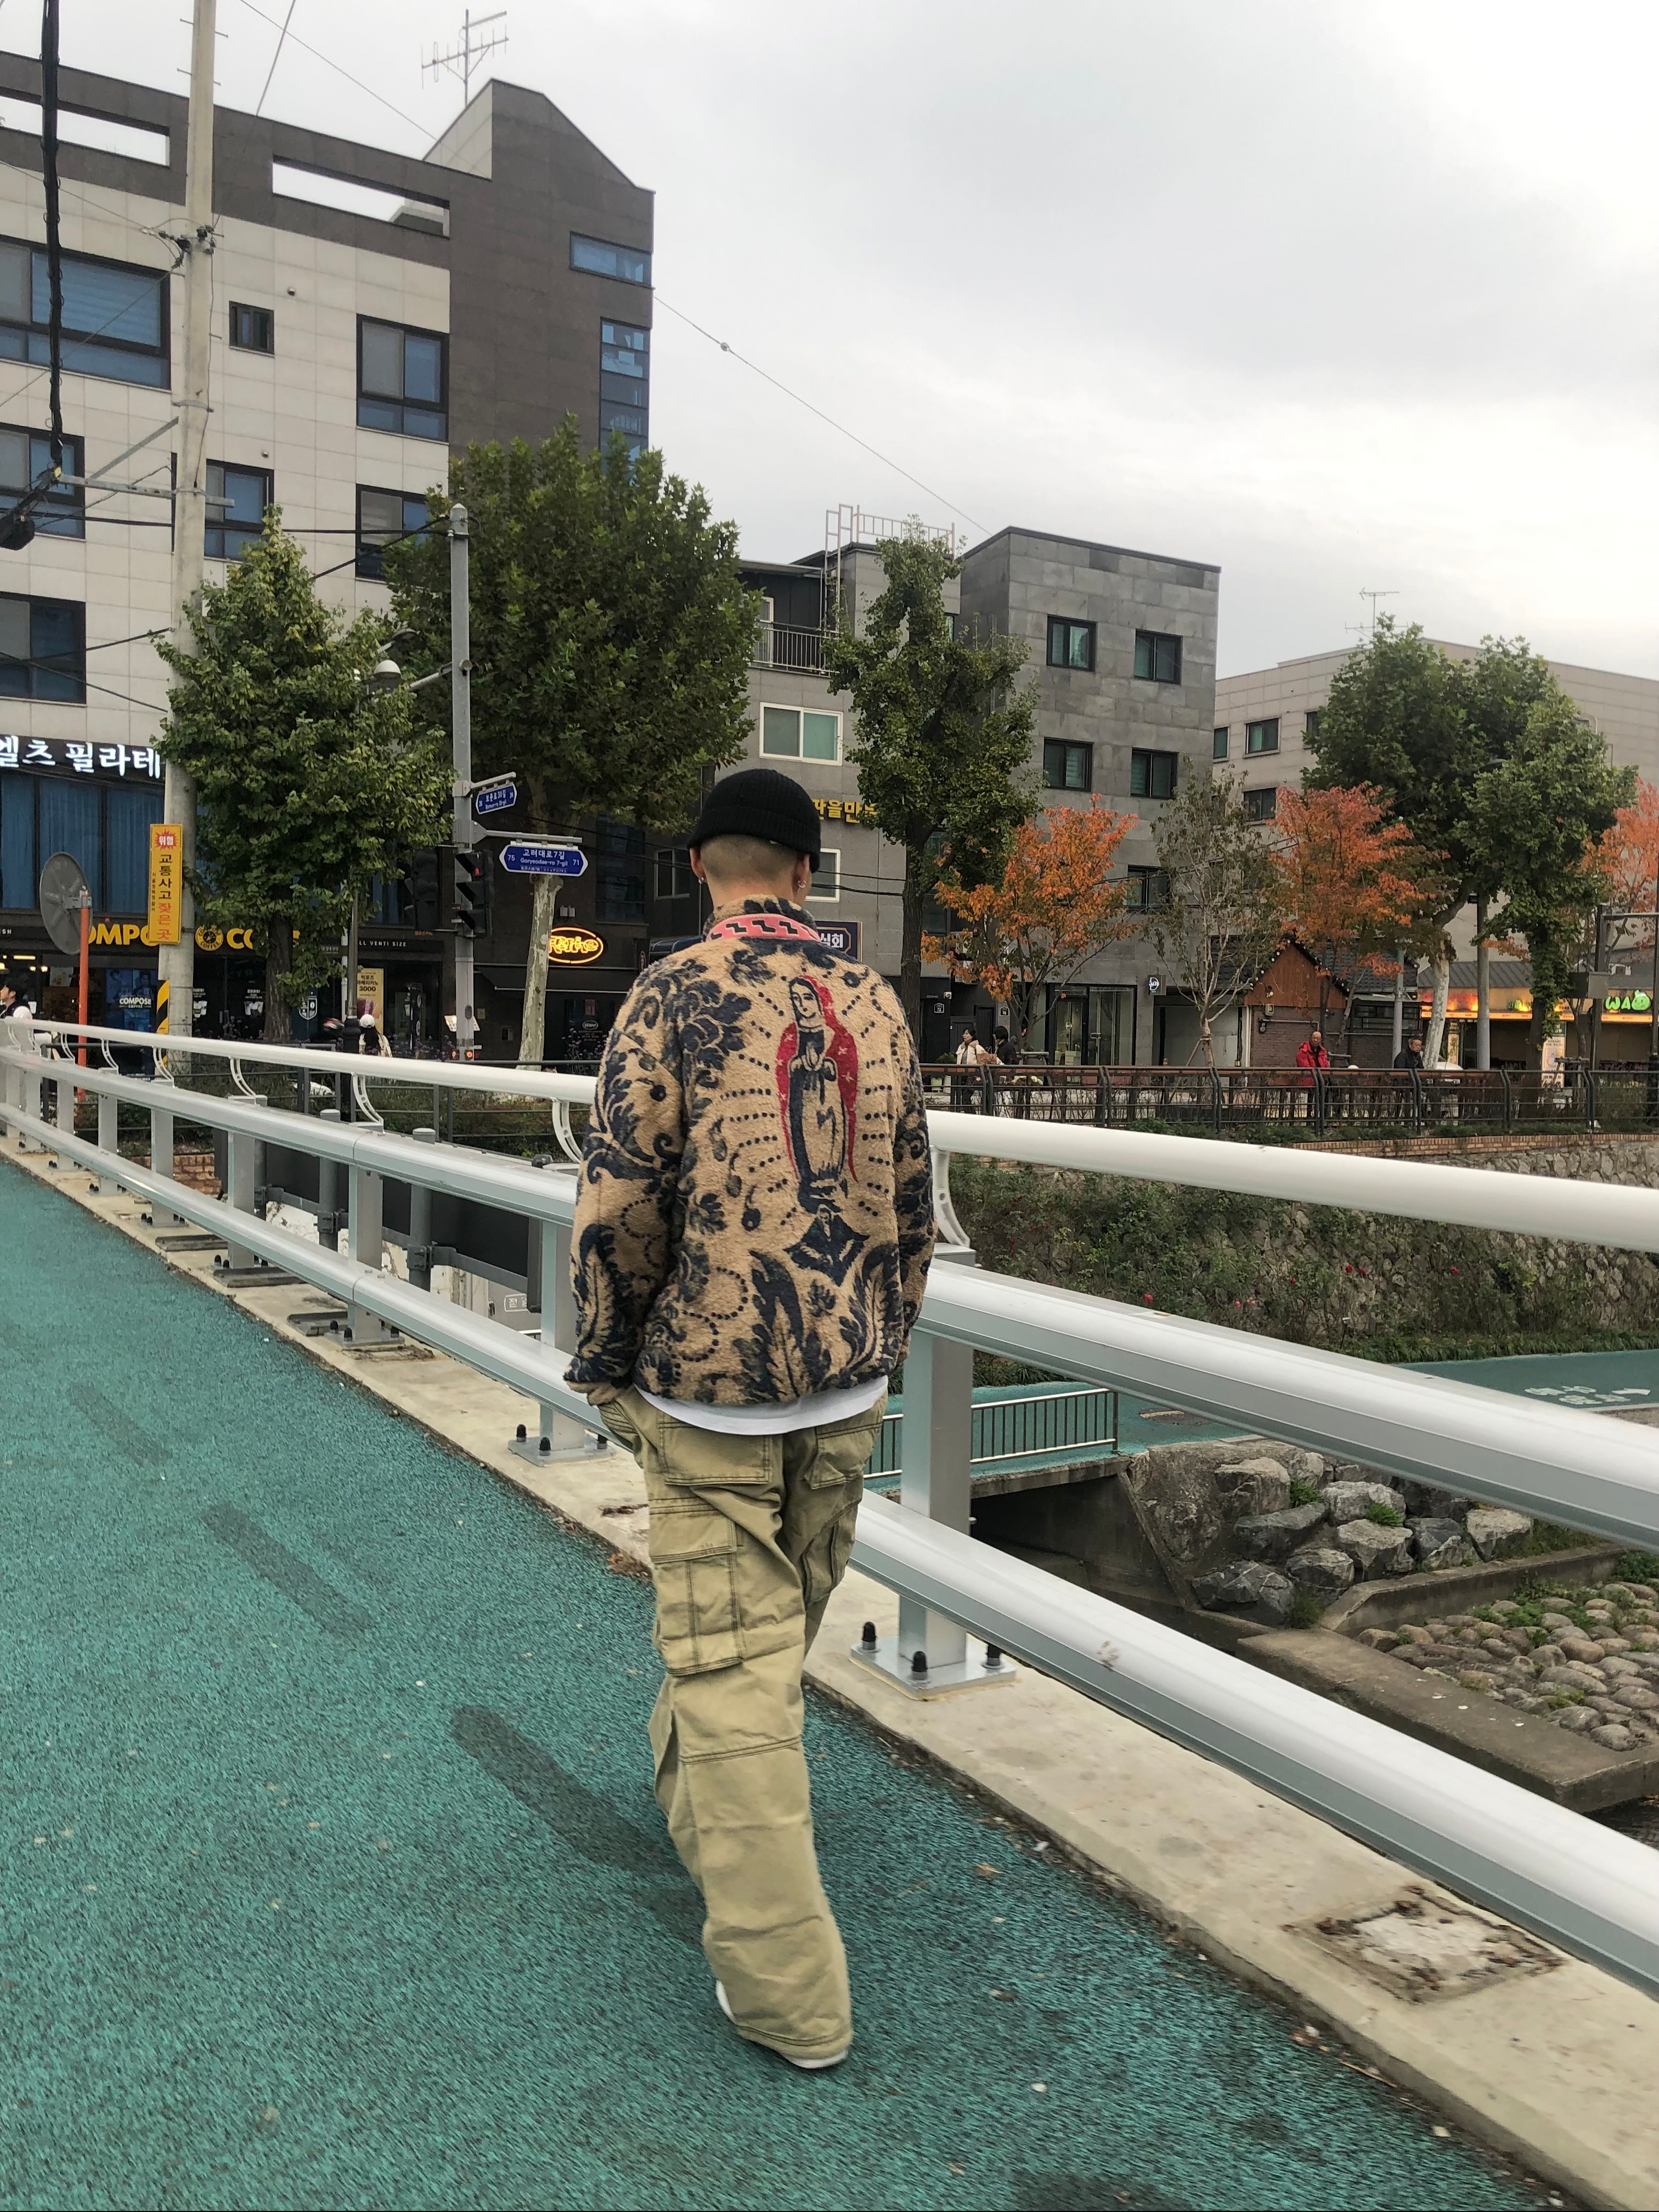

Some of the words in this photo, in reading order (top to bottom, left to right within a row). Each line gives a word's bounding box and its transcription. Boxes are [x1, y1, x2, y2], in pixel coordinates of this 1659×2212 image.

[159, 836, 174, 846] 위험
[523, 849, 565, 860] 고려대로7길
[159, 854, 173, 900] 교통사고
[157, 902, 172, 925] 잦은
[156, 929, 171, 940] 곳
[119, 997, 152, 1005] COMPOSE
